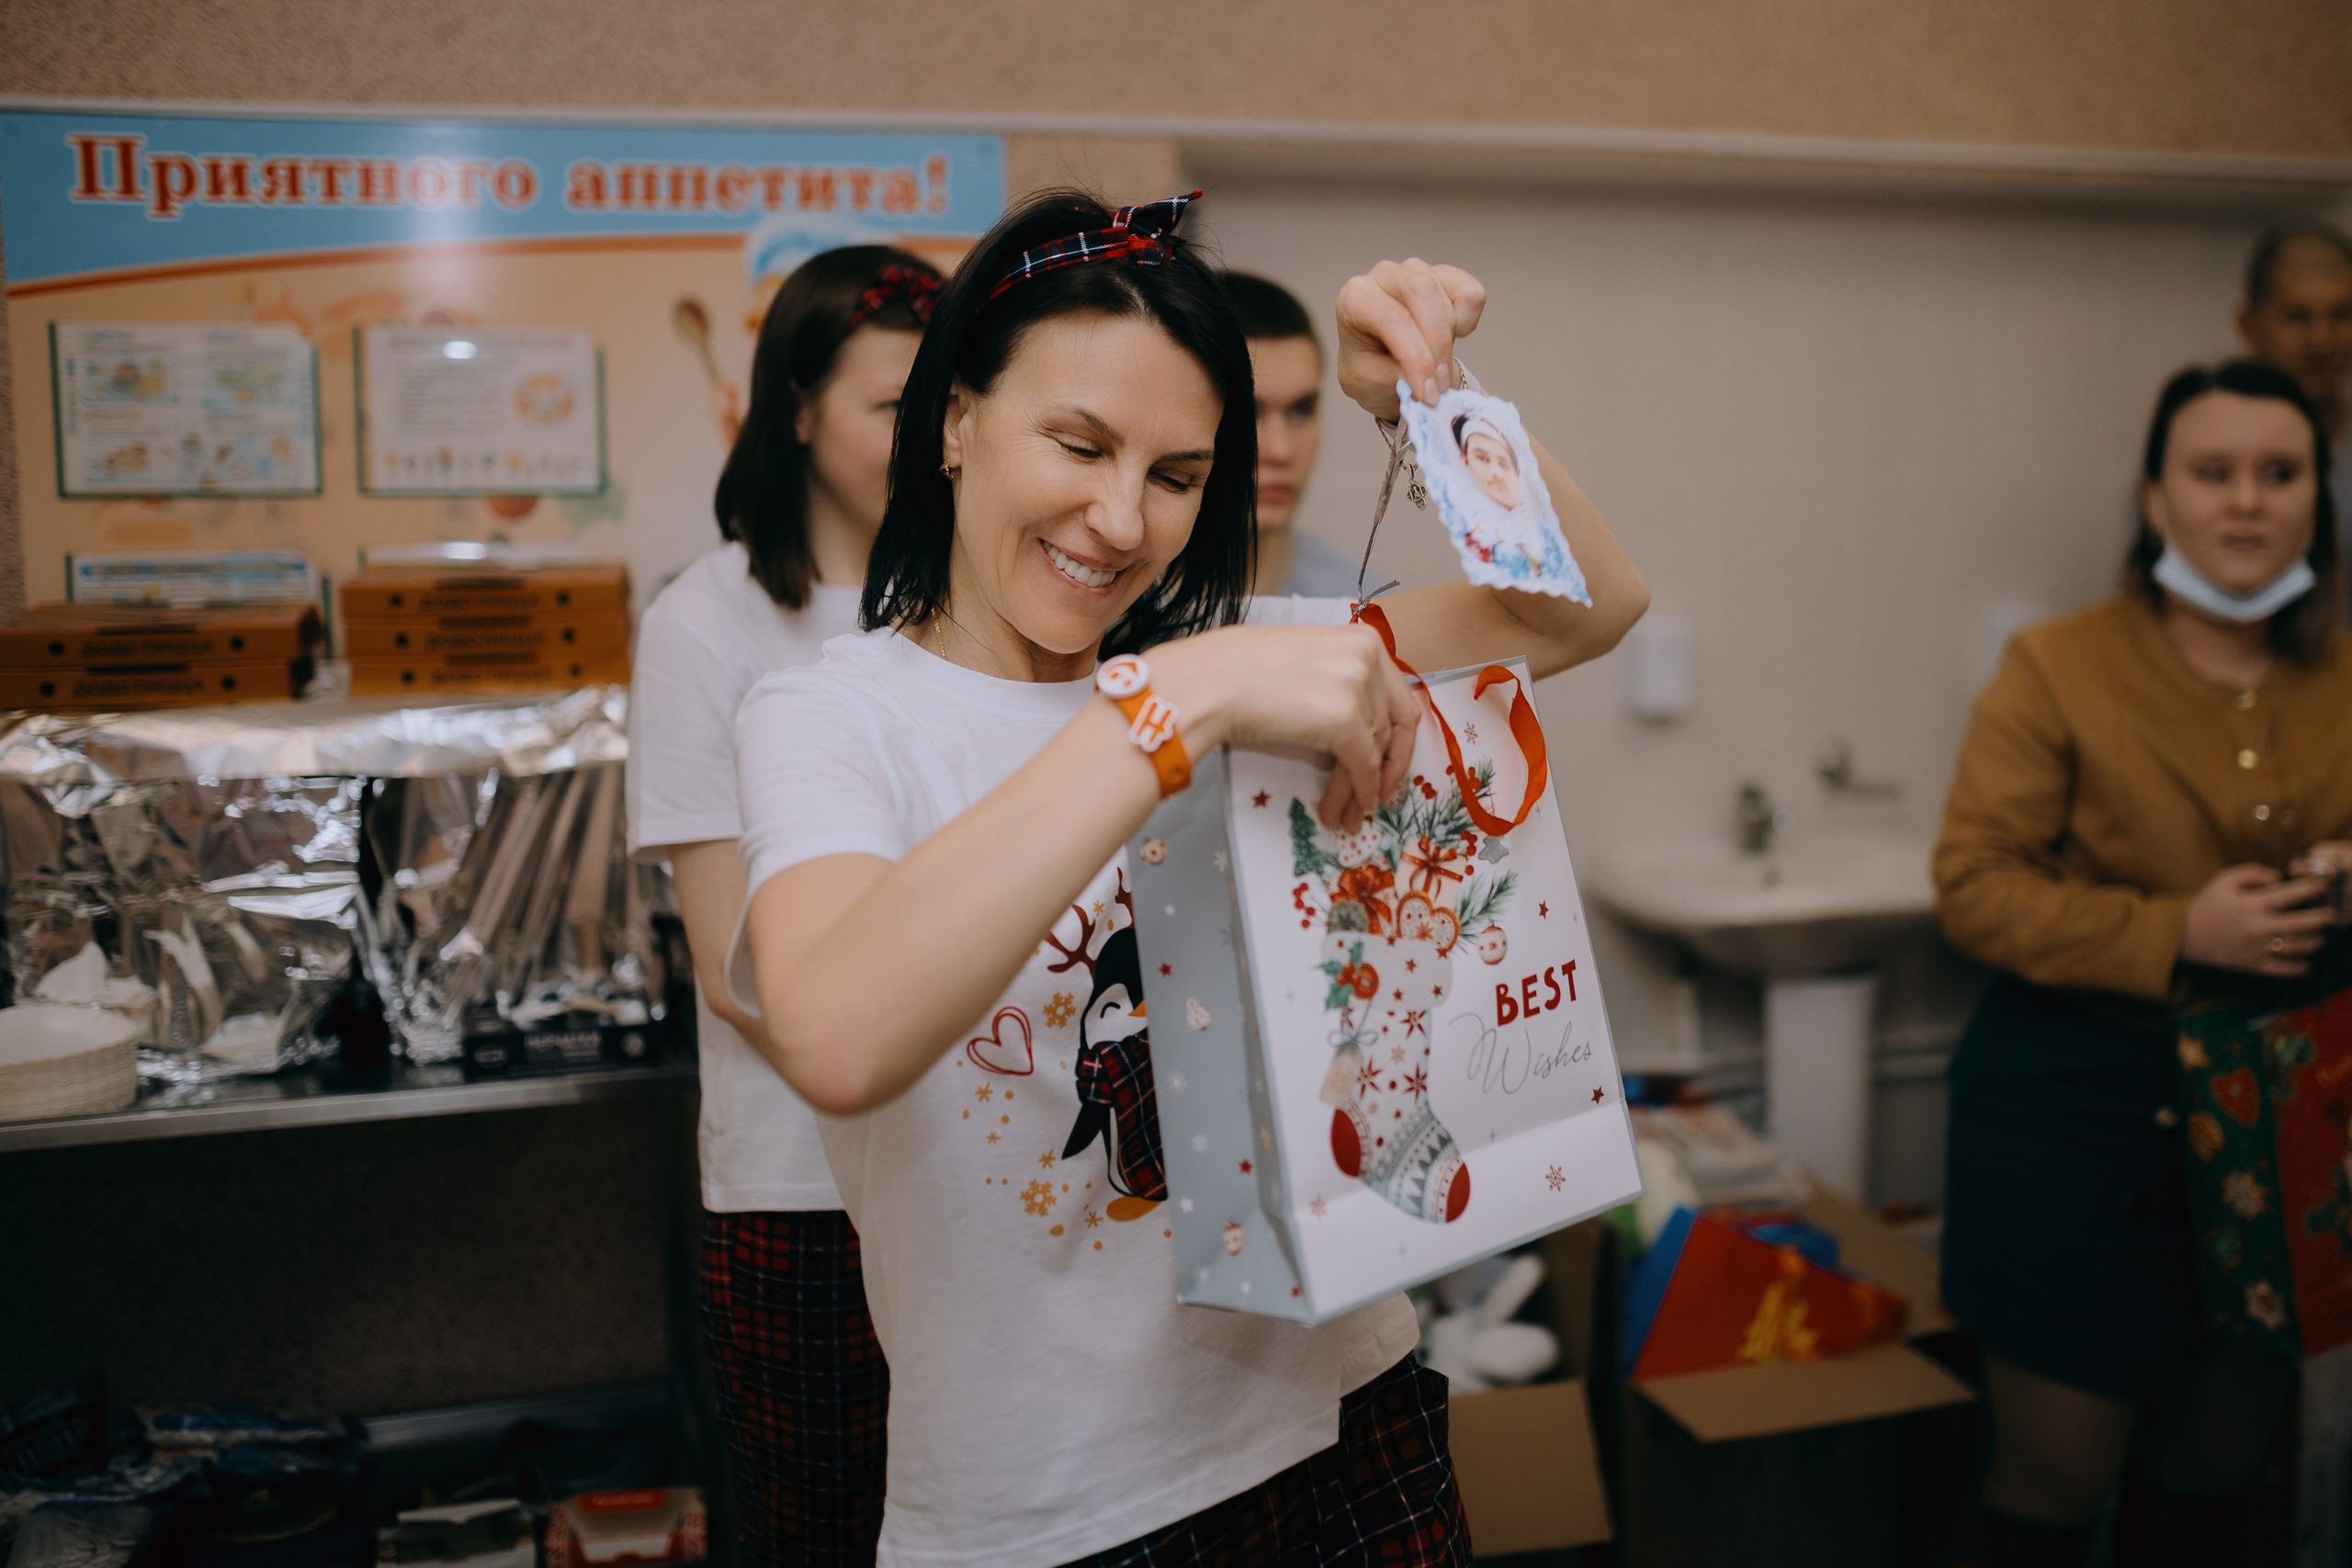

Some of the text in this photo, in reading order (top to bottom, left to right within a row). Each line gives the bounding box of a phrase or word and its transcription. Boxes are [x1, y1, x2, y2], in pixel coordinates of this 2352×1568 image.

[68, 133, 948, 220] Приятного аппетита!
[1496, 959, 1577, 1027] BEST
[1447, 1012, 1593, 1095] Wishes
